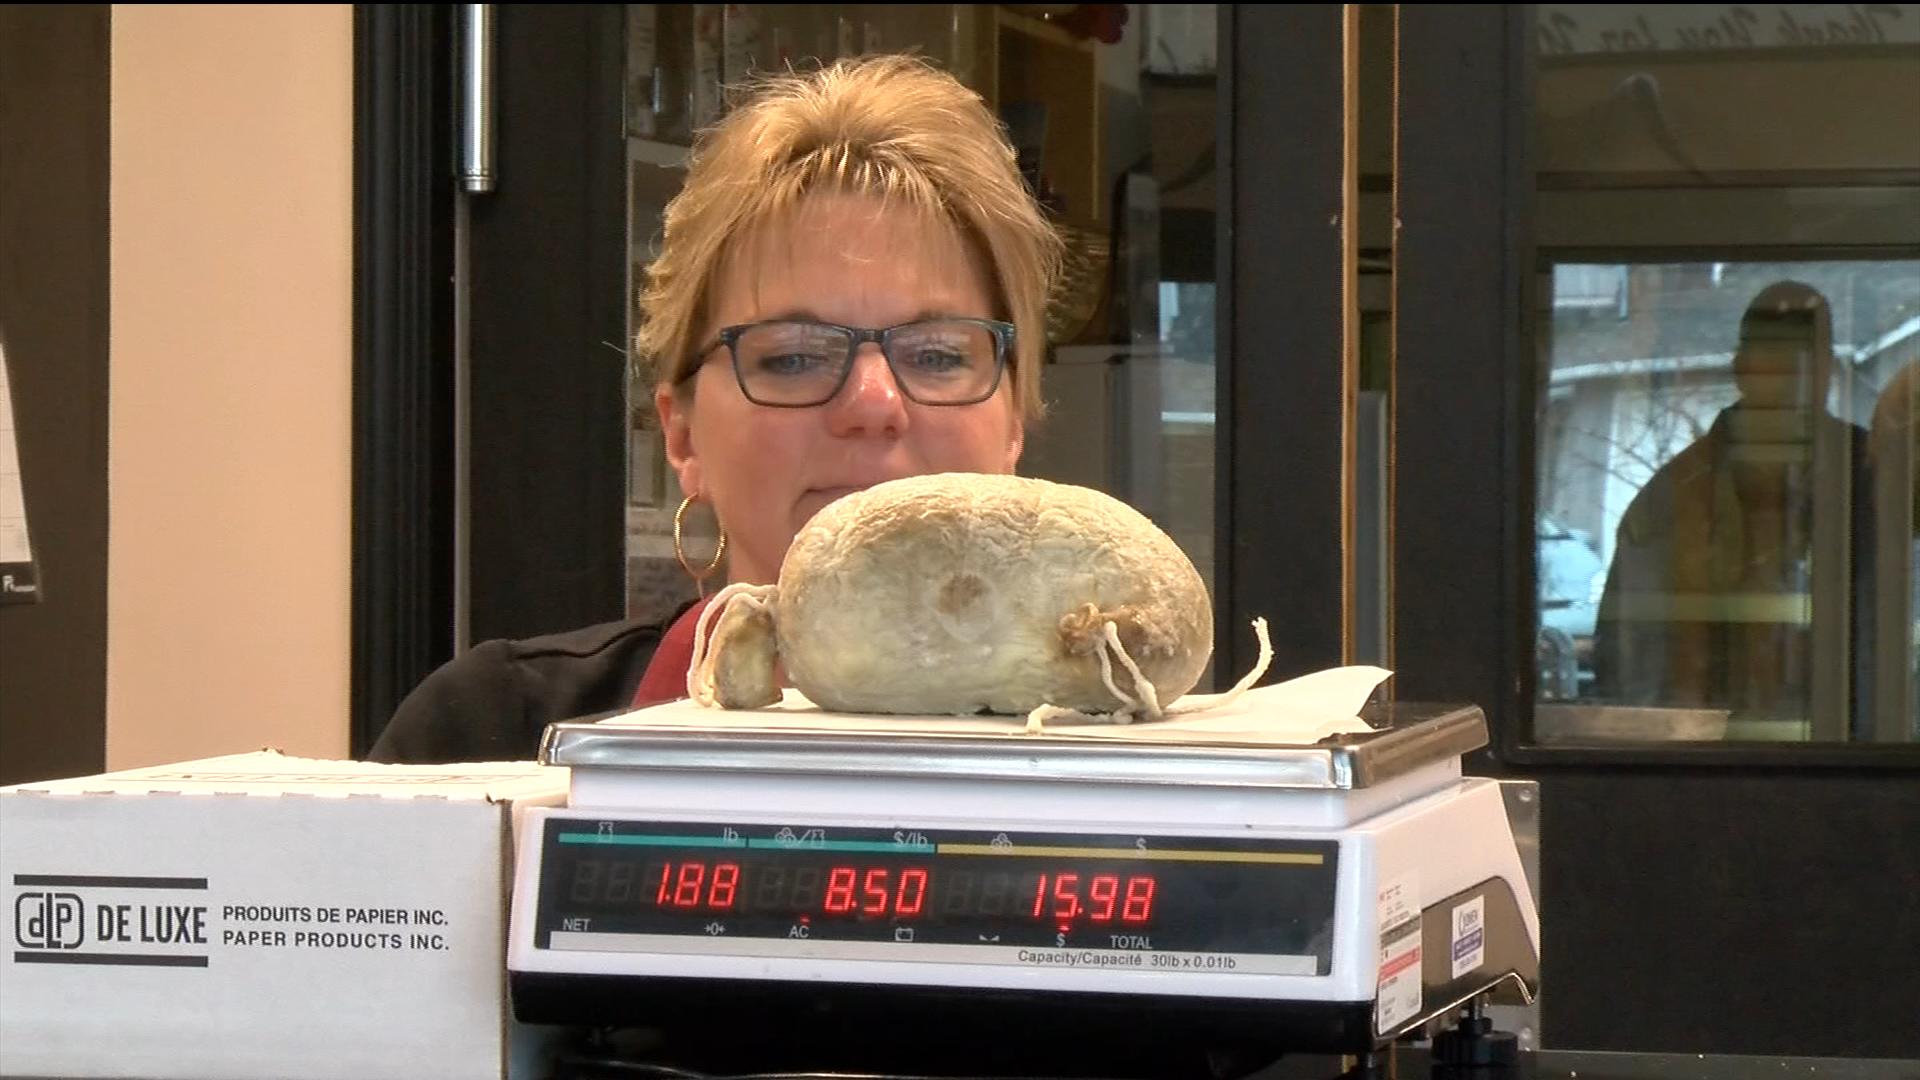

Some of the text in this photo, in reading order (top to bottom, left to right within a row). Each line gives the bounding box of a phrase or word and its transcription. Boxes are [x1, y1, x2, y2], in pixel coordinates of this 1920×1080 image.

[723, 827, 739, 842] lb
[893, 830, 928, 848] $/lb
[656, 863, 740, 907] 1.88
[824, 867, 928, 913] 8.50
[1032, 873, 1156, 921] 15.98
[97, 904, 208, 944] DE LUXE
[222, 906, 449, 926] PRODUITS DE PAPIER INC.
[562, 918, 592, 932] NET
[222, 930, 450, 950] PAPER PRODUCTS INC.
[788, 925, 810, 939] AC
[1055, 933, 1066, 948] $
[1110, 935, 1153, 949] TOTAL
[1018, 950, 1237, 969] Capacity/Capacité 30lb x 0.01lb
